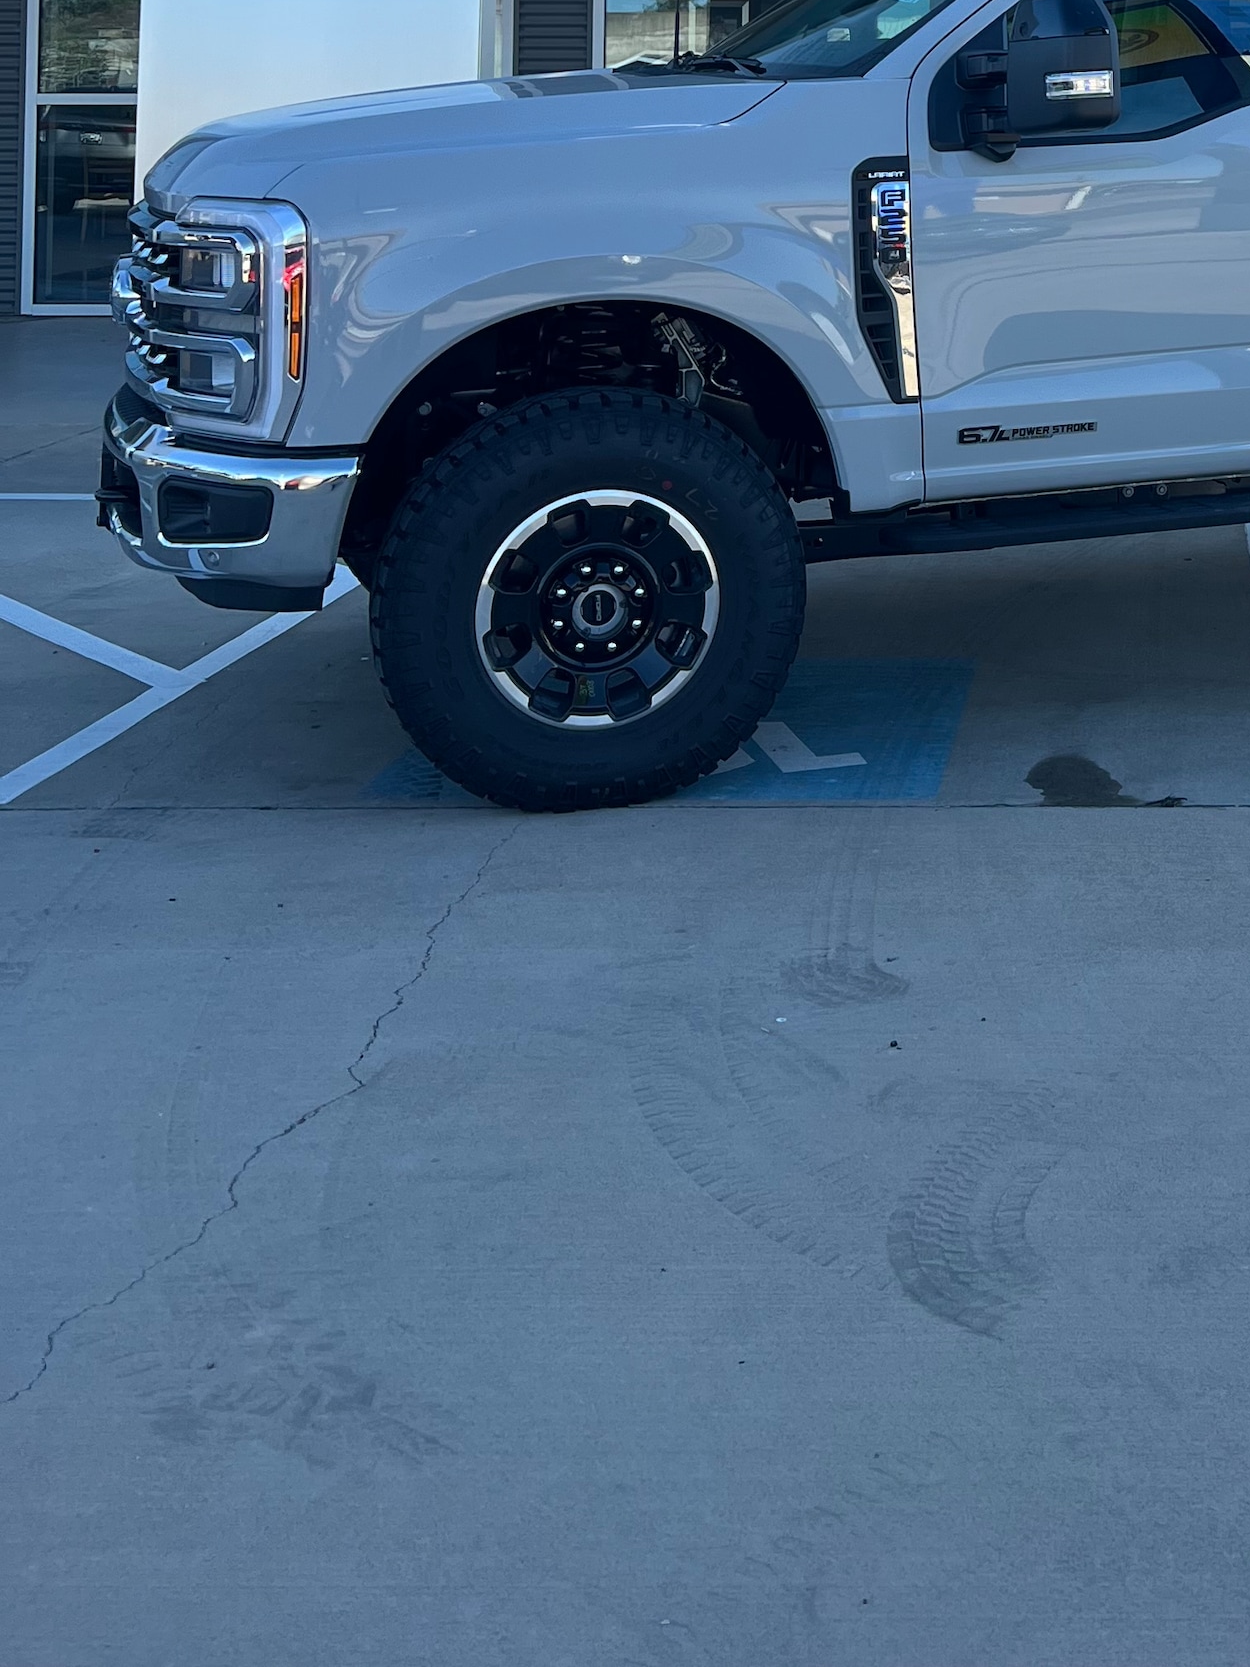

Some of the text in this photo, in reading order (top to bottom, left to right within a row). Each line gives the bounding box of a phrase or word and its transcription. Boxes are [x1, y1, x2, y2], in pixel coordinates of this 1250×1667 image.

[868, 170, 906, 179] LARIAT
[957, 425, 1010, 444] 6.7L
[1011, 425, 1050, 437] POWER
[1052, 421, 1095, 434] STROKE
